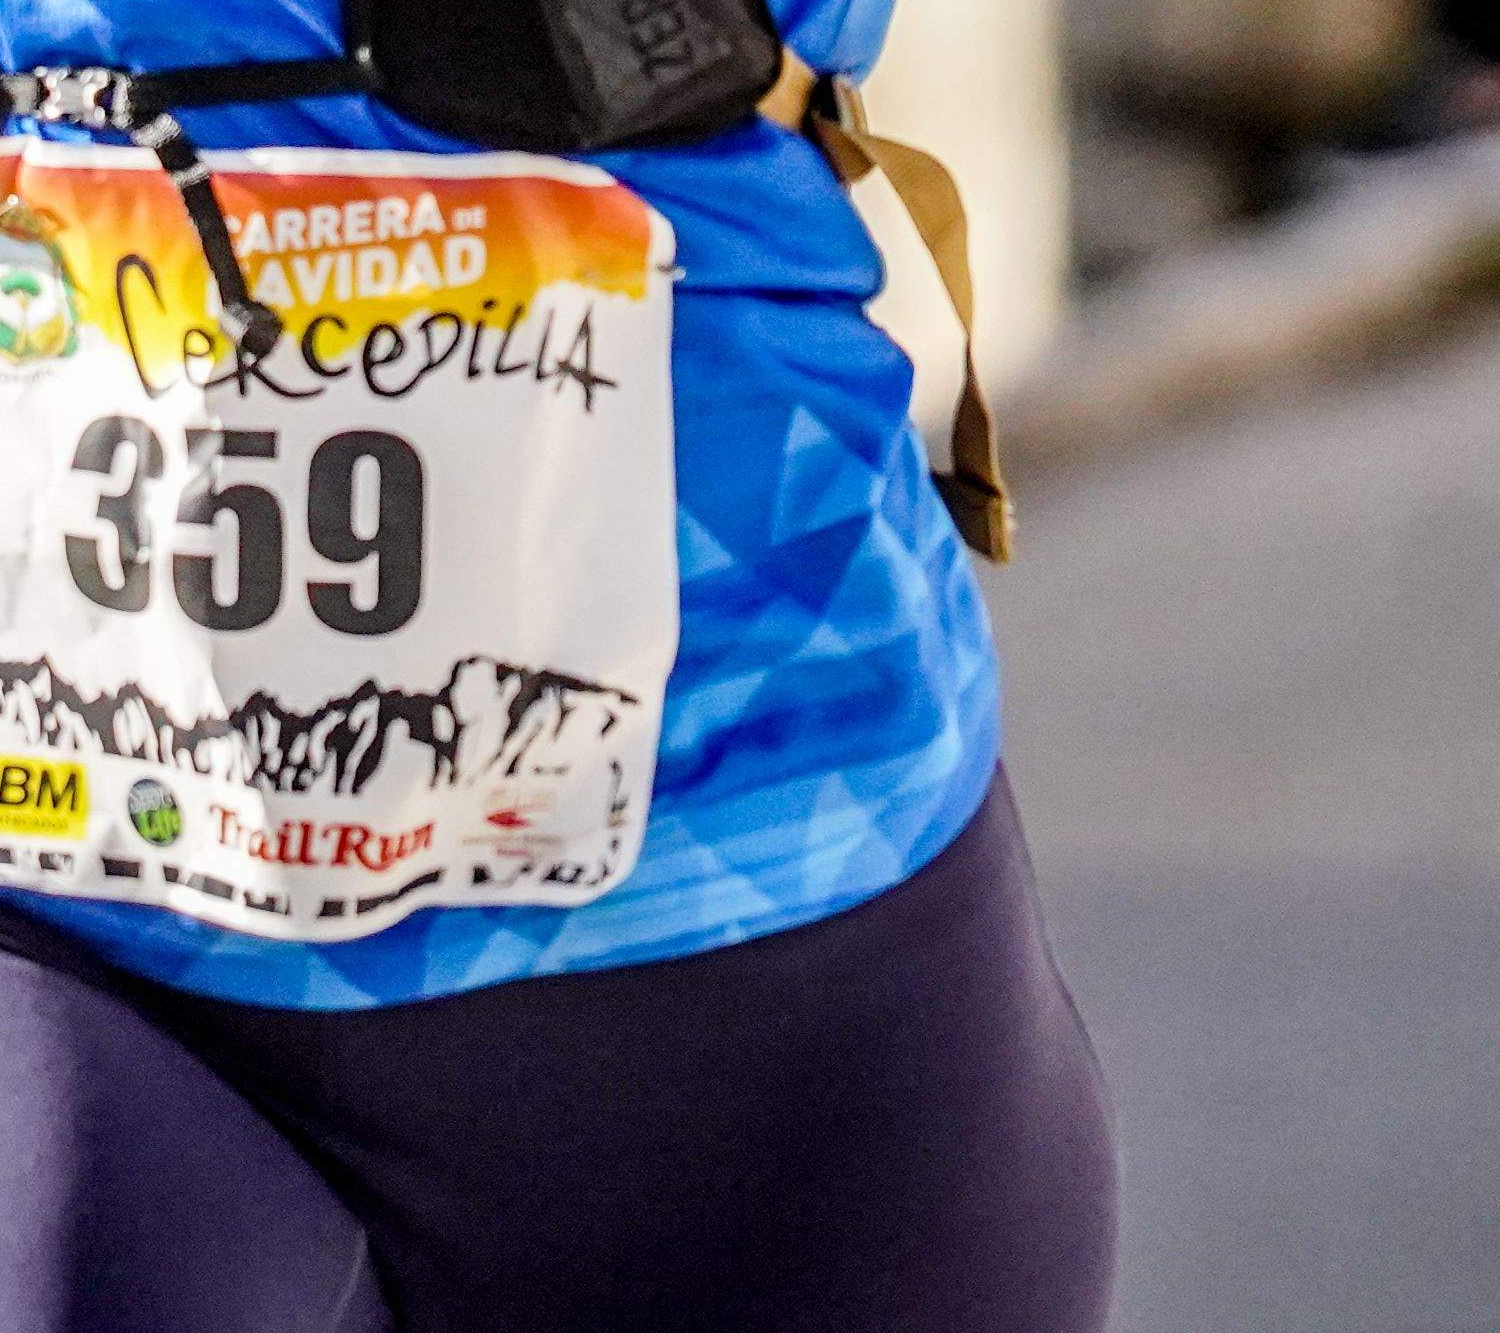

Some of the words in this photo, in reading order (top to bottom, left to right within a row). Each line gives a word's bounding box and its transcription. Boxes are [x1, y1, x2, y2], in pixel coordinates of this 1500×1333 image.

[227, 191, 447, 257] ARRERA
[451, 204, 488, 232] DE
[207, 236, 488, 316] AVIDAD
[65, 414, 425, 637] 359
